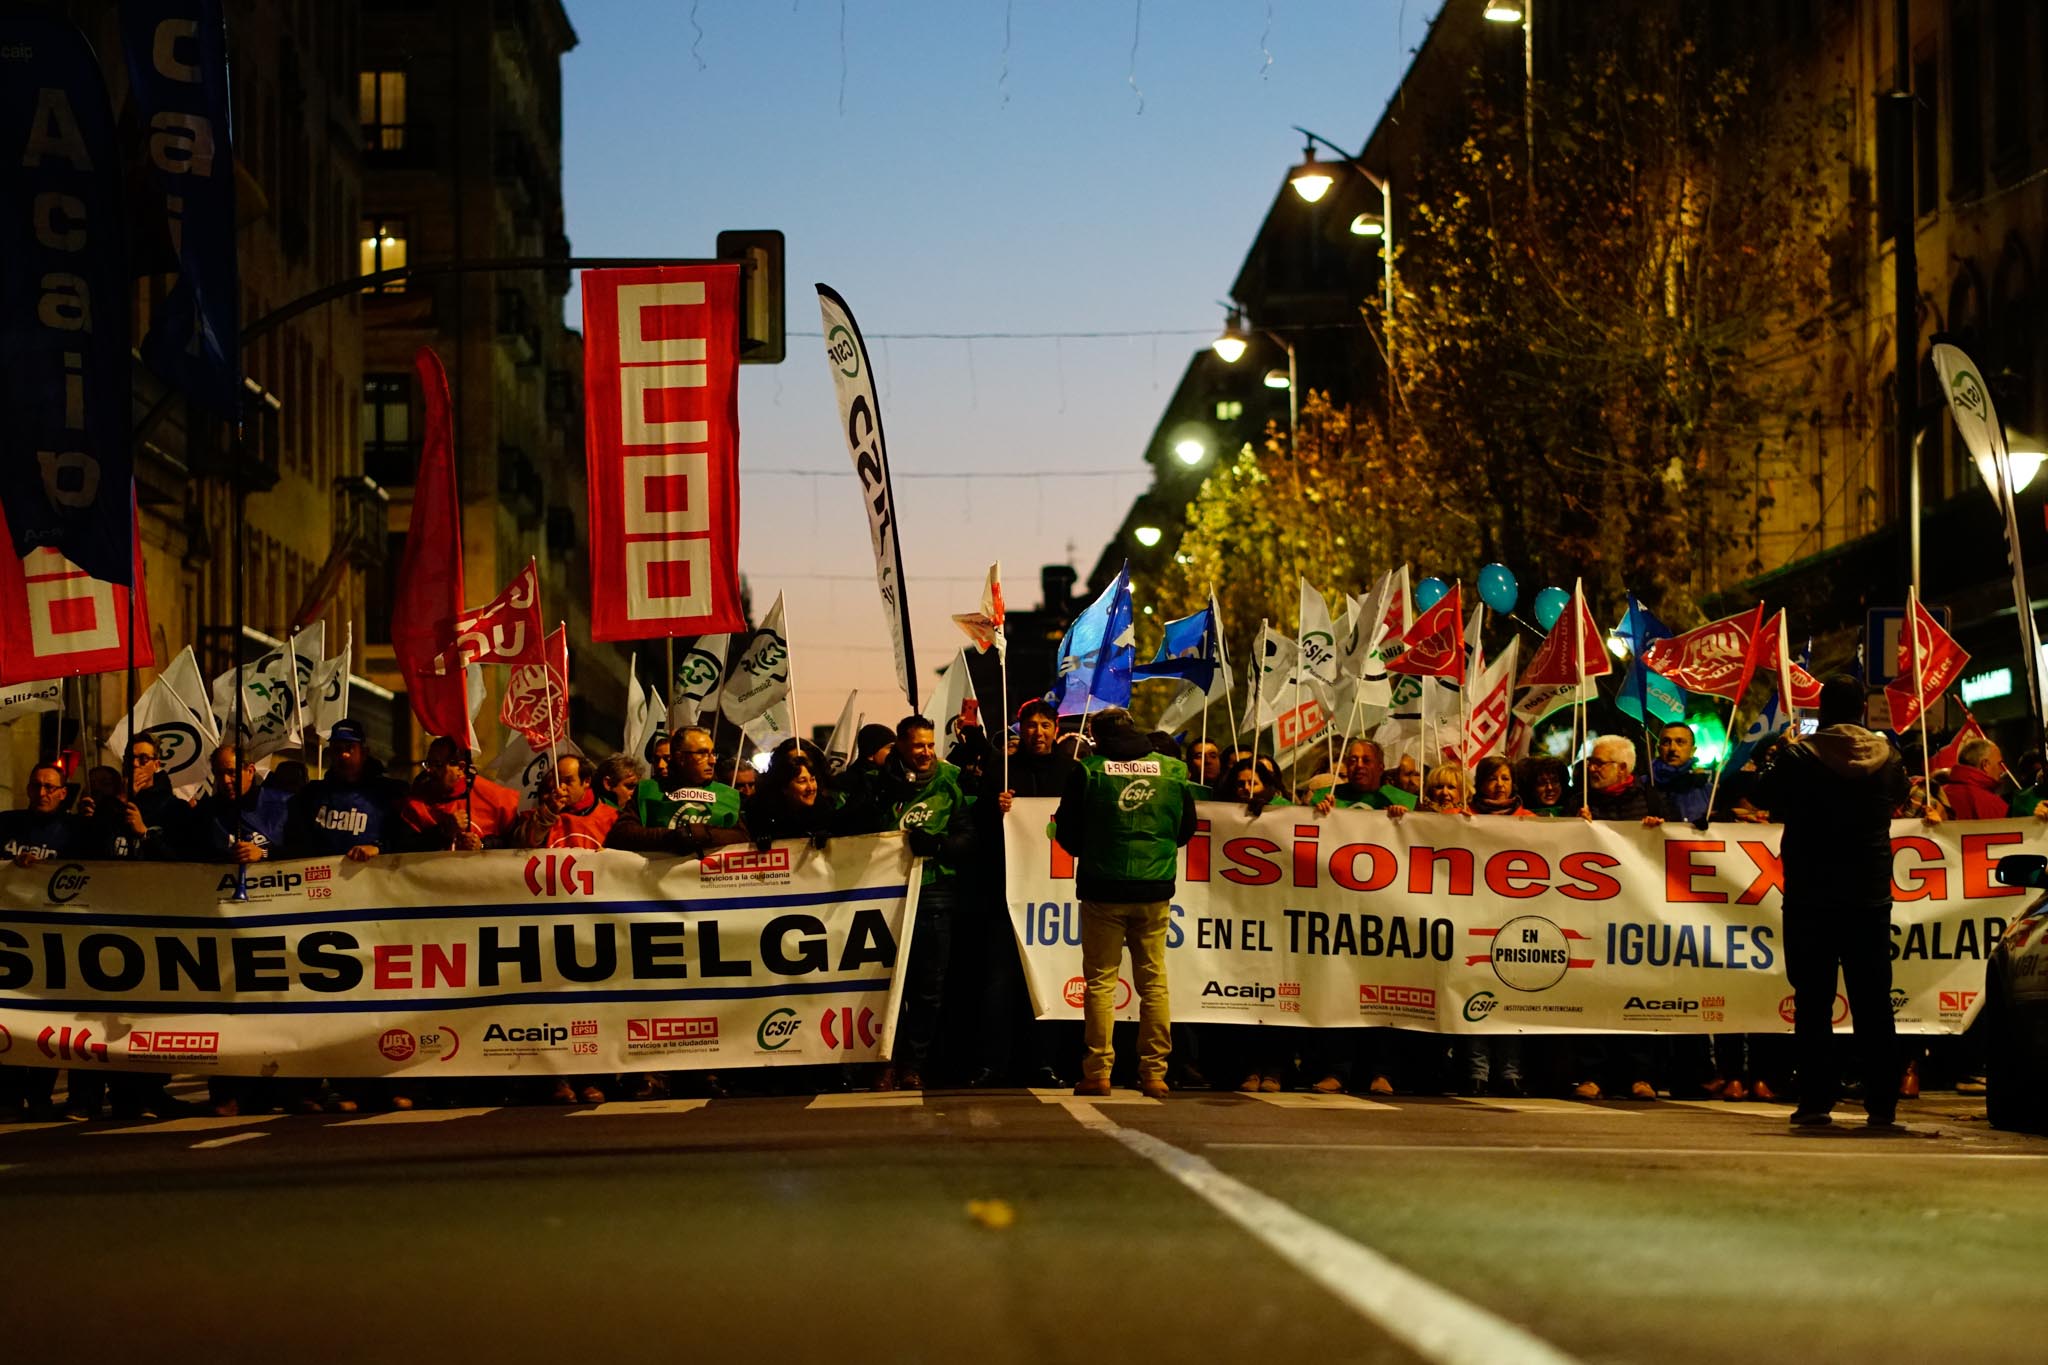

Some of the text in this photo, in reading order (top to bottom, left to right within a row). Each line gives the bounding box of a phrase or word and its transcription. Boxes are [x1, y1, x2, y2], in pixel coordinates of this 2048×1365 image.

[22, 86, 104, 514] Acaip
[616, 281, 713, 621] CCOO
[315, 806, 369, 836] Acaip
[728, 851, 788, 869] CCOO
[1049, 813, 1621, 906] isiones
[306, 869, 331, 881] EPSU
[524, 854, 595, 897] CIG
[700, 874, 733, 882] servicios
[1663, 834, 2027, 905] EXGE
[216, 870, 301, 892] Acaip
[1197, 917, 1231, 949] EN
[1242, 919, 1272, 952] EL
[1284, 908, 1456, 962] TRABAJO
[1522, 929, 1538, 944] EN
[0, 908, 898, 993] SIONES EN HUELGA
[1606, 922, 1775, 970] IGUALES
[1495, 947, 1567, 964] PRISIONES
[1201, 980, 1275, 1002] Acaip
[1384, 990, 1433, 1006] CCOO
[1470, 1000, 1499, 1013] CSIF
[1623, 996, 1699, 1014] Acaip
[482, 1022, 569, 1047] Acaip
[573, 1025, 597, 1036] EPSU
[655, 1019, 716, 1037] CCOO
[765, 1019, 803, 1037] CSIF
[37, 1025, 110, 1063] CIG
[156, 1034, 217, 1050] CCOO
[382, 1033, 411, 1049] UGT
[628, 1041, 661, 1049] servicios
